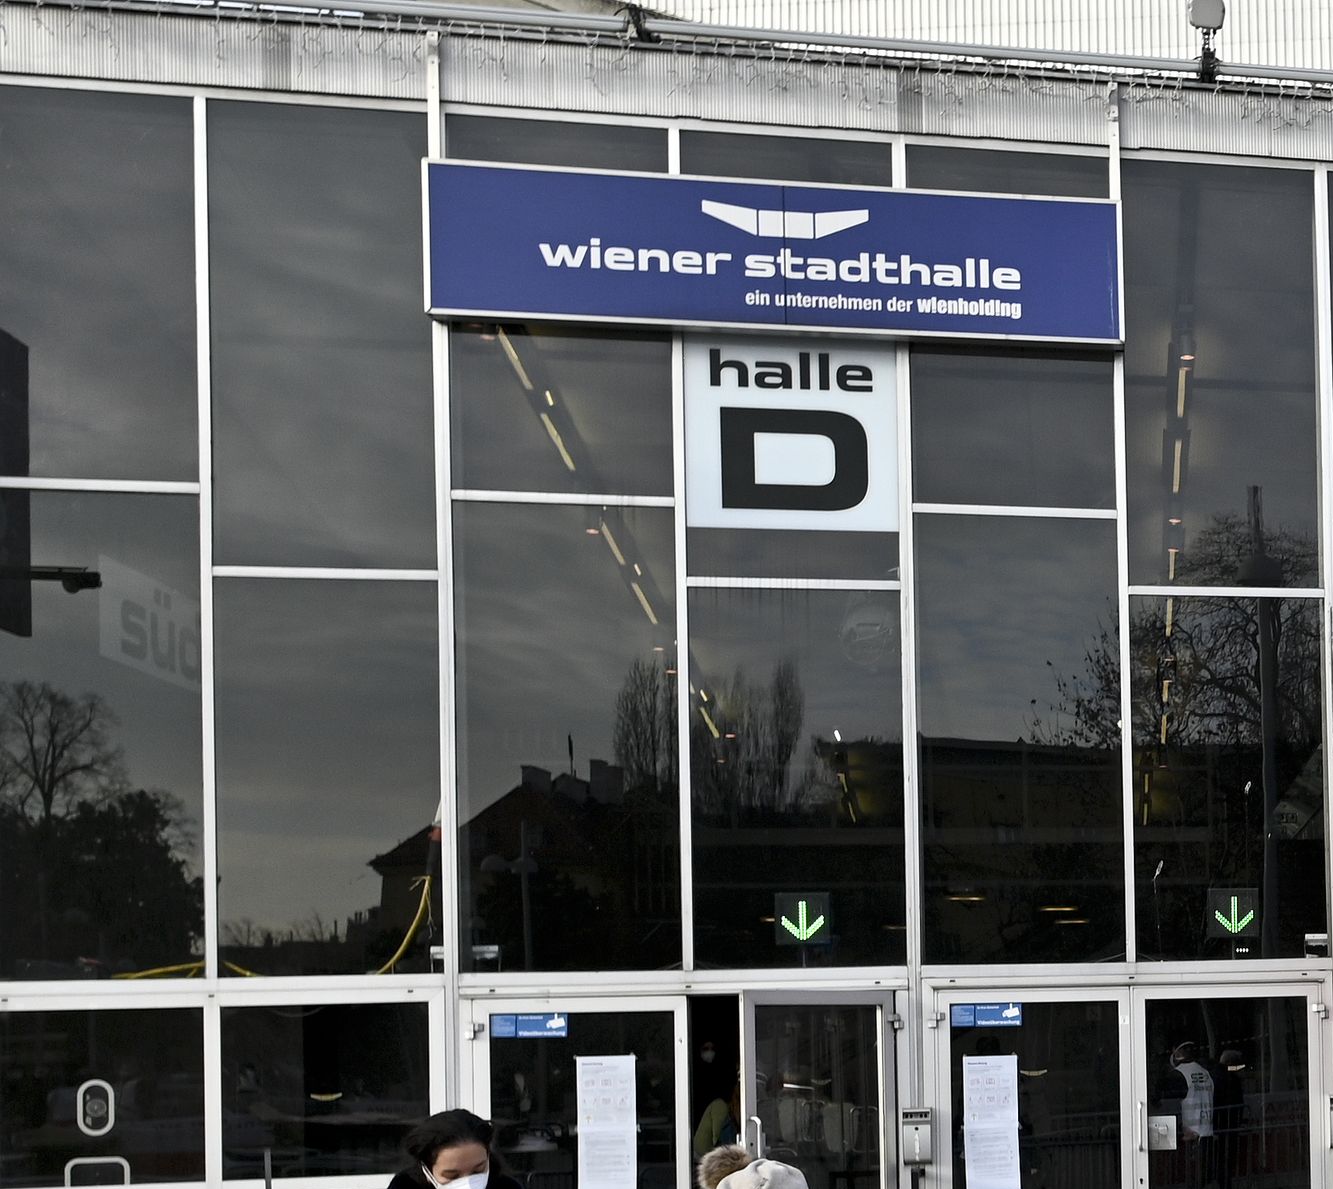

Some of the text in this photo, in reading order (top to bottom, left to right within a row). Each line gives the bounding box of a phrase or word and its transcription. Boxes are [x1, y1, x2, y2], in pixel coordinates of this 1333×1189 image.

[538, 238, 1022, 290] wiener stadthalle
[745, 290, 771, 306] ein
[775, 291, 882, 312] unternehmen
[887, 297, 914, 314] der
[709, 348, 873, 392] halle
[719, 406, 869, 512] D
